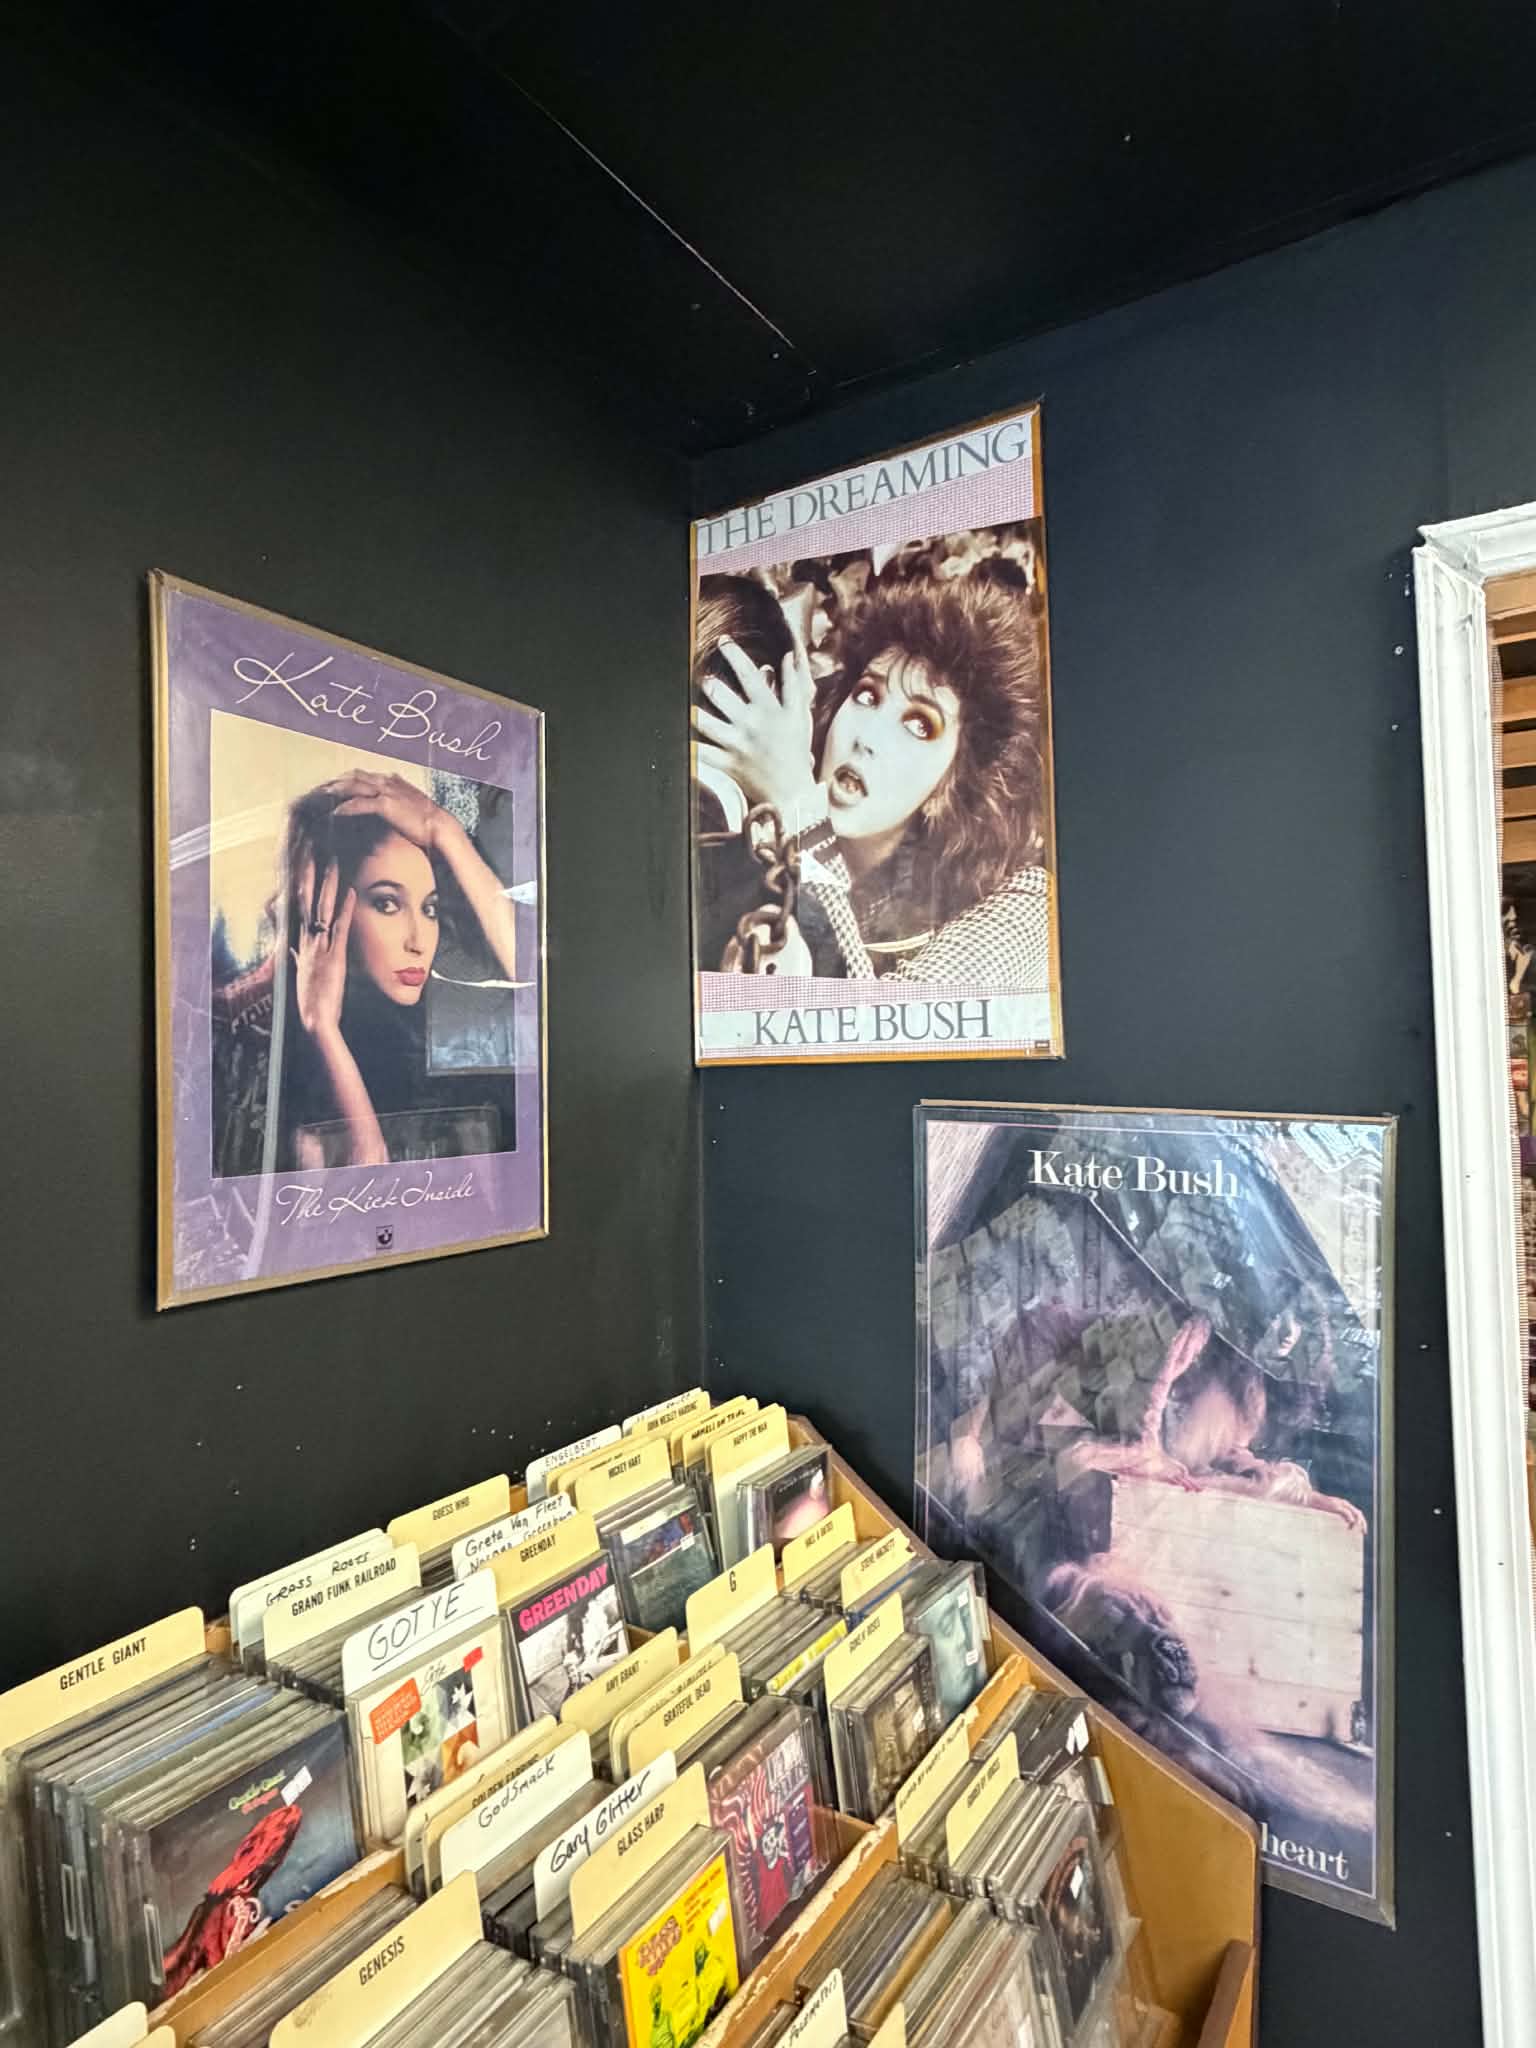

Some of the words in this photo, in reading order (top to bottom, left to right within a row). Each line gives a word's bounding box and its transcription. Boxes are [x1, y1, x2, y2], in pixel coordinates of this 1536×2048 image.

[698, 501, 777, 554] THE
[786, 421, 1028, 530] DREAMING
[233, 652, 374, 725] Kate
[377, 690, 502, 761] Bush
[752, 1006, 860, 1046] KATE
[871, 999, 993, 1042] BUSH
[276, 1184, 325, 1225] The
[328, 1178, 400, 1225] Kick
[401, 1171, 475, 1207] Inside
[1027, 1149, 1124, 1191] Kate
[1131, 1155, 1240, 1198] Bush
[465, 1529, 504, 1557] Greta
[510, 1513, 529, 1530] Van
[520, 1534, 556, 1562] GREENDAY
[292, 1591, 324, 1617] GRAND
[327, 1579, 351, 1600] FUNK
[354, 1558, 397, 1587] RAILROAD
[729, 1570, 737, 1593] G
[367, 1582, 464, 1661] GOTYE
[59, 1656, 105, 1690] GENTLE
[113, 1637, 147, 1665] GIANT
[664, 1694, 694, 1727] GRATEFUL
[695, 1679, 711, 1701] DEAD
[550, 1824, 591, 1873] Gary
[596, 1769, 651, 1836] Glitter
[617, 1822, 643, 1856] GLASS
[644, 1803, 664, 1831] HARP
[1260, 1822, 1349, 1881] heart
[358, 1935, 405, 1986] GENESIS
